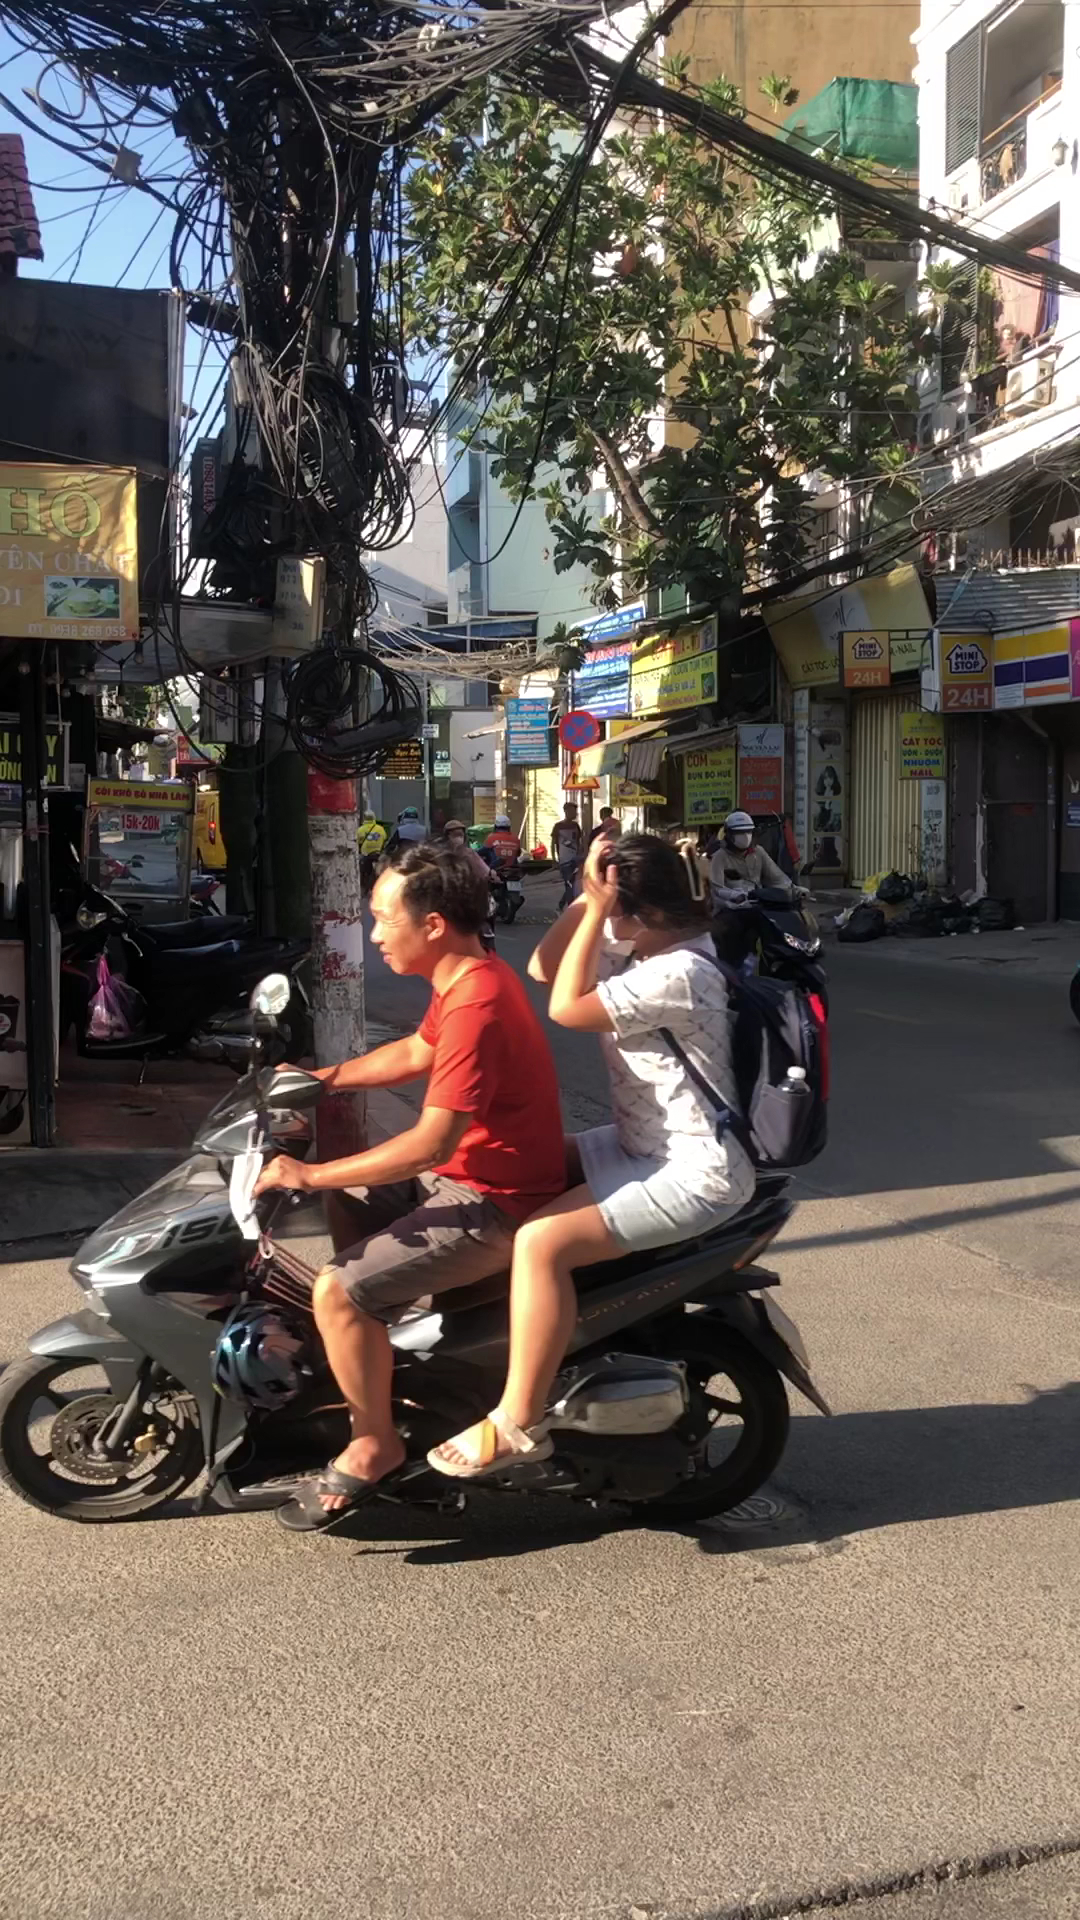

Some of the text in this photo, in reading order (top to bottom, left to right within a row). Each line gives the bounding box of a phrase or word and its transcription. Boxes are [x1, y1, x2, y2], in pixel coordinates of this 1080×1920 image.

[955, 651, 978, 660] MINI
[954, 661, 980, 670] STOP
[853, 672, 882, 685] 24H
[947, 687, 989, 707] 24H
[121, 814, 160, 831] 15k-20k
